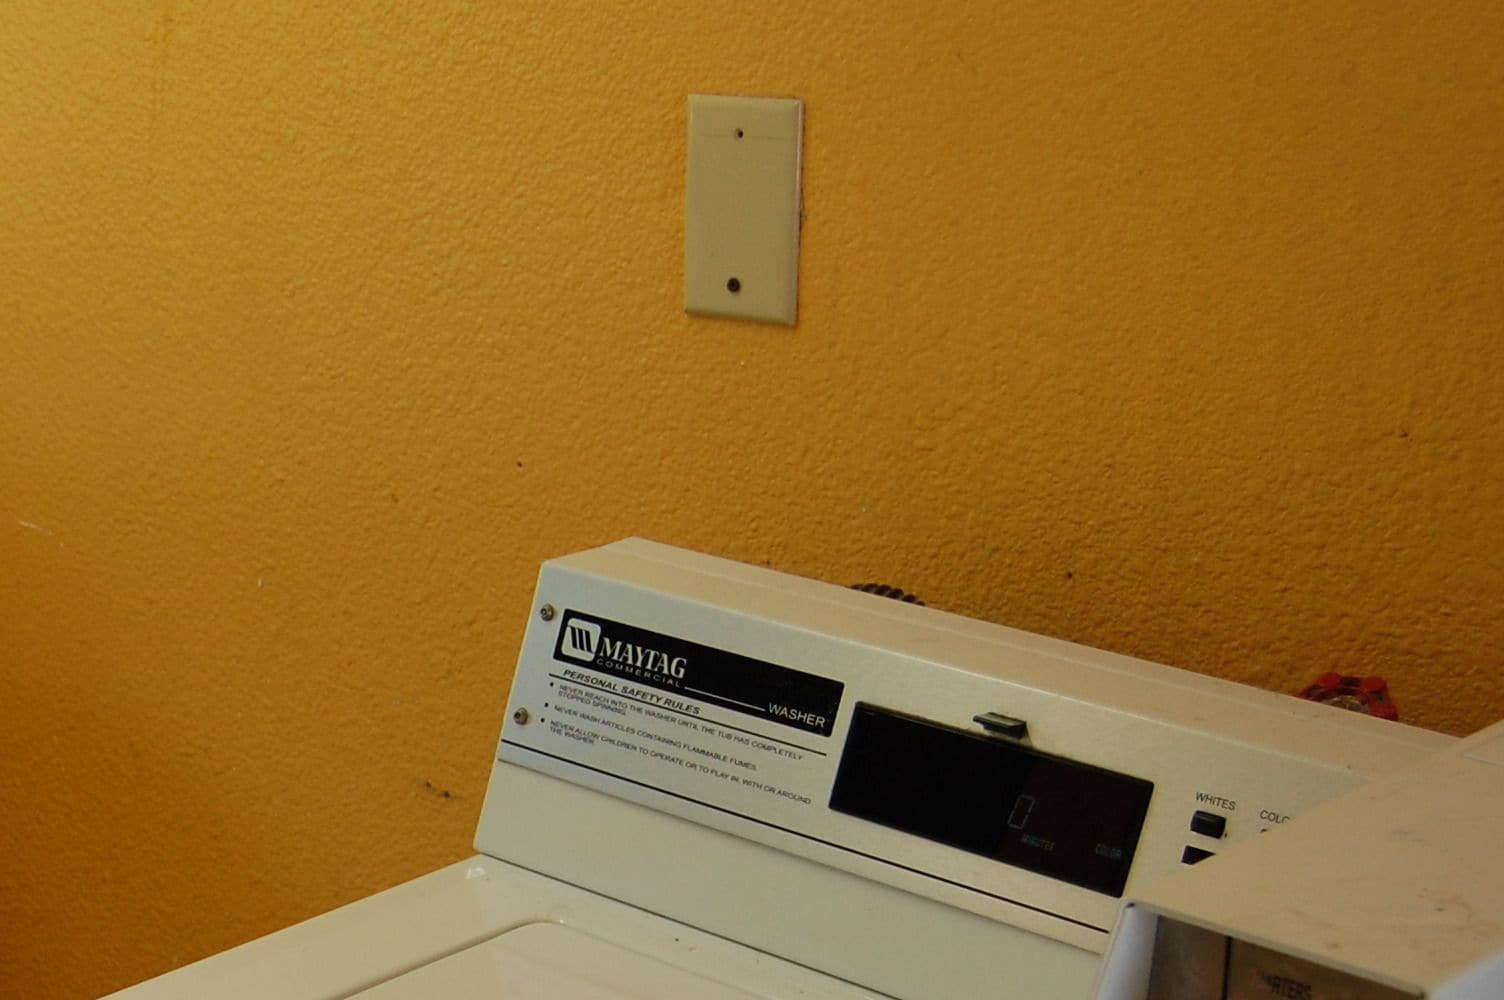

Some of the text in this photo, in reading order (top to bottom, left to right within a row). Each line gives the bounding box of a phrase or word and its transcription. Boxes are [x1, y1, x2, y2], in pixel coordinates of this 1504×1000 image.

[596, 658, 681, 688] COMMERCIAL
[600, 637, 687, 679] MAYTAG
[563, 669, 702, 715] PERSONAL SAFETY RULES
[554, 704, 578, 716] NEVER
[600, 719, 636, 735] ARTICLES
[636, 729, 682, 749] CONTAINING
[683, 744, 728, 762] FLAMMABLE
[560, 684, 803, 760] NEVER REACH INTO THE WASHER UNTIL THE TUB HAS COMPLETELY
[768, 703, 826, 728] WASHER
[550, 720, 575, 732] NEVER
[600, 735, 638, 751] CHILDREN
[639, 747, 649, 756] TO
[649, 750, 684, 766] OPERATE
[685, 761, 698, 769] OR
[699, 765, 709, 774] TO
[710, 769, 730, 780] PLAY
[742, 779, 763, 790] WITH
[764, 785, 776, 794] OR
[777, 789, 812, 805] AROUND
[1196, 791, 1237, 811] WHITES
